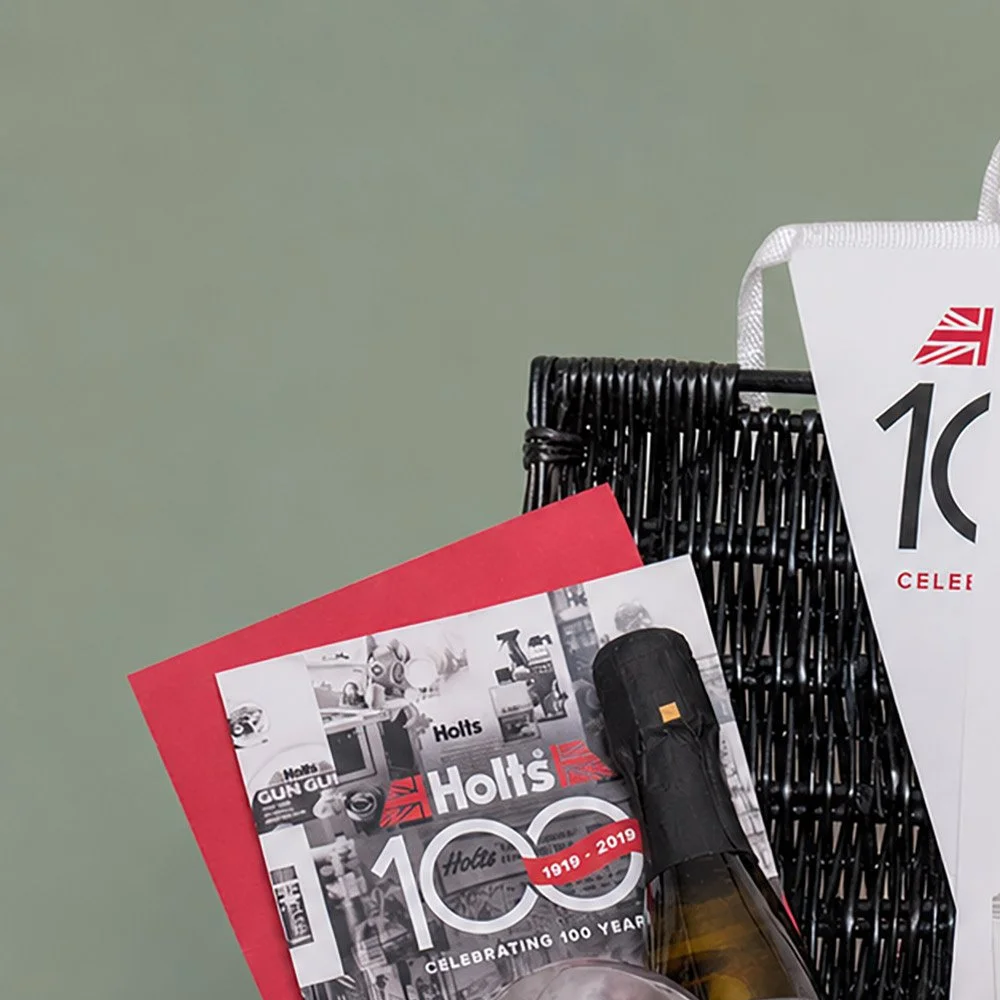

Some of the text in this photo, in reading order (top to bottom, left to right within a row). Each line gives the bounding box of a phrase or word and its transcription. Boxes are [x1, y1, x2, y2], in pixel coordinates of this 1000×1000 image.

[432, 718, 483, 743] Holts
[257, 783, 302, 805] GUN
[371, 796, 644, 951] 100
[542, 857, 581, 879] 1919
[596, 828, 636, 855] 2019
[425, 934, 553, 975] CELEBRATING
[560, 925, 592, 944] 100
